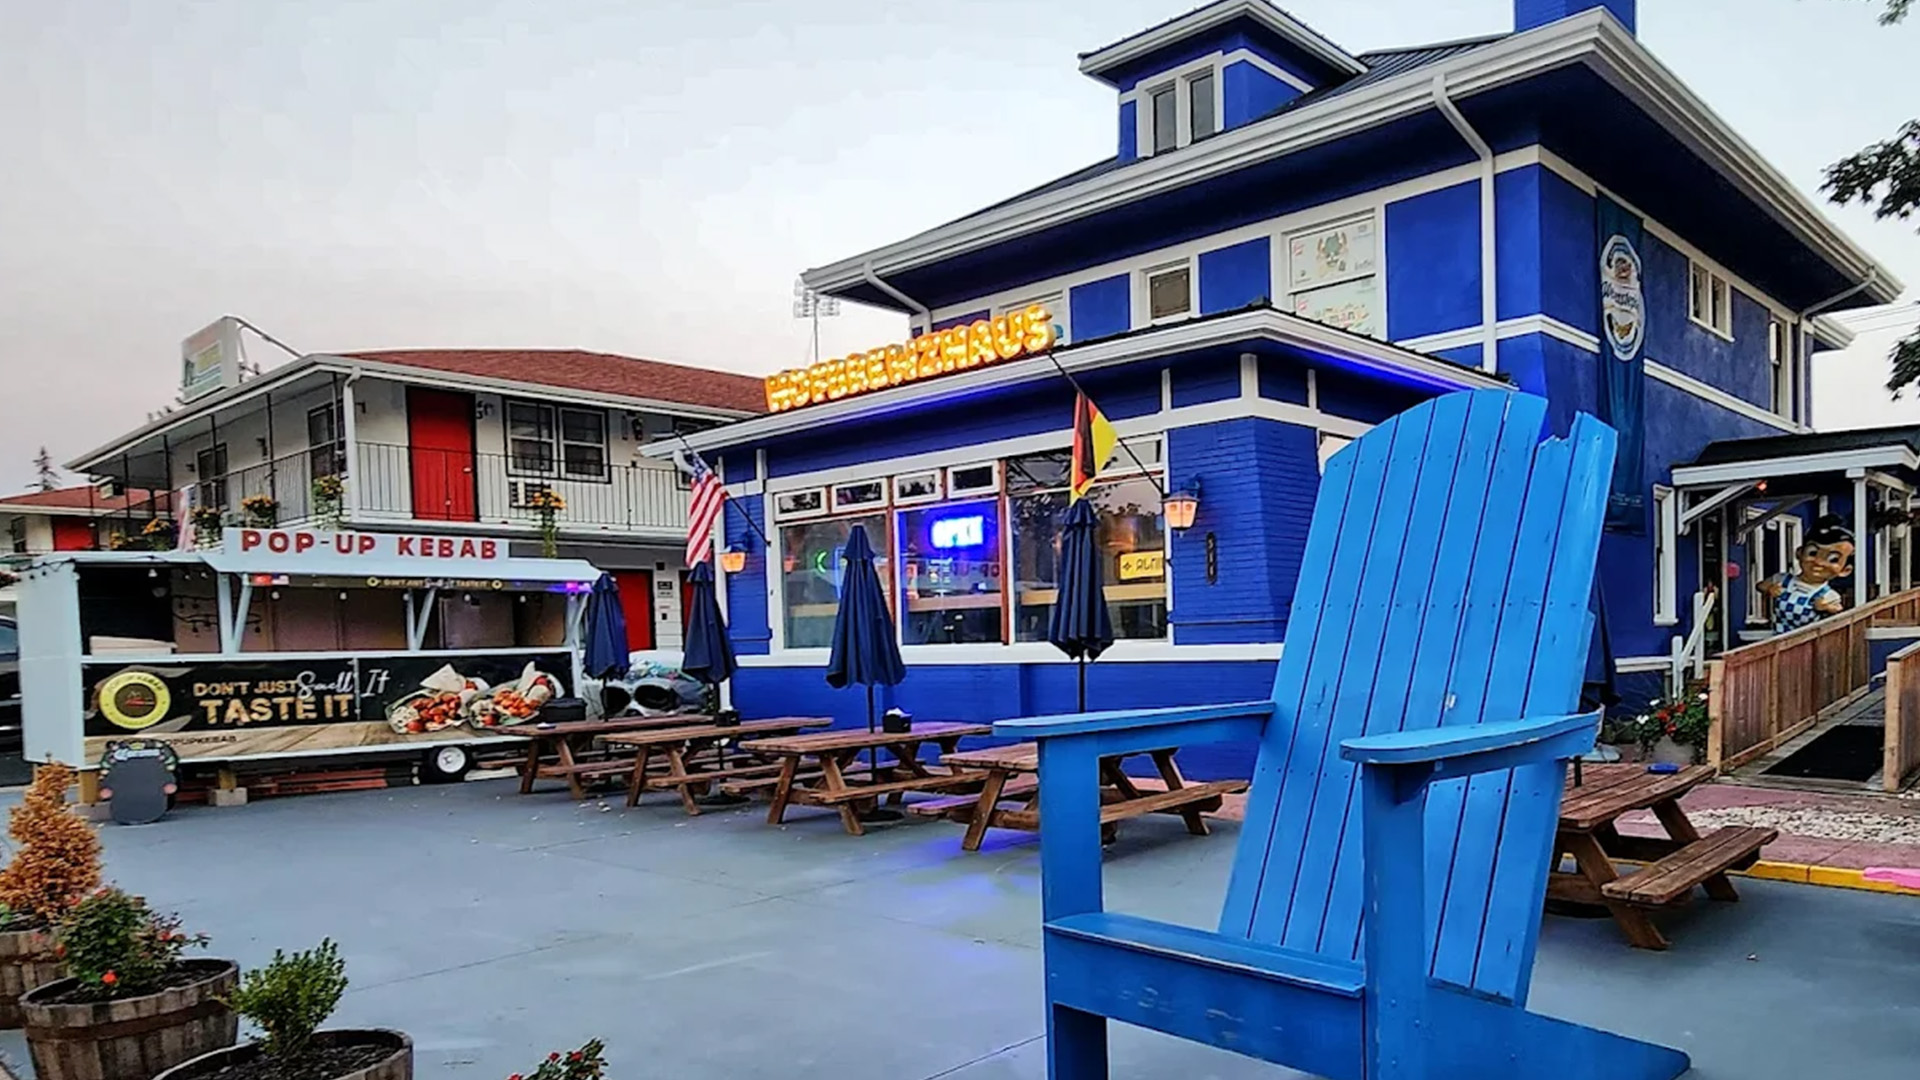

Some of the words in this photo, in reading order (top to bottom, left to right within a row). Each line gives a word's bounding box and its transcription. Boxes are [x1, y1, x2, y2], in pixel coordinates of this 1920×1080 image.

[241, 530, 376, 555] POP-UP
[397, 536, 498, 560] KEBAB
[193, 681, 250, 697] DON'T
[254, 680, 298, 694] JUST
[296, 670, 353, 699] Smell
[361, 669, 391, 698] It
[200, 696, 318, 725] TASTE
[324, 694, 354, 718] IT
